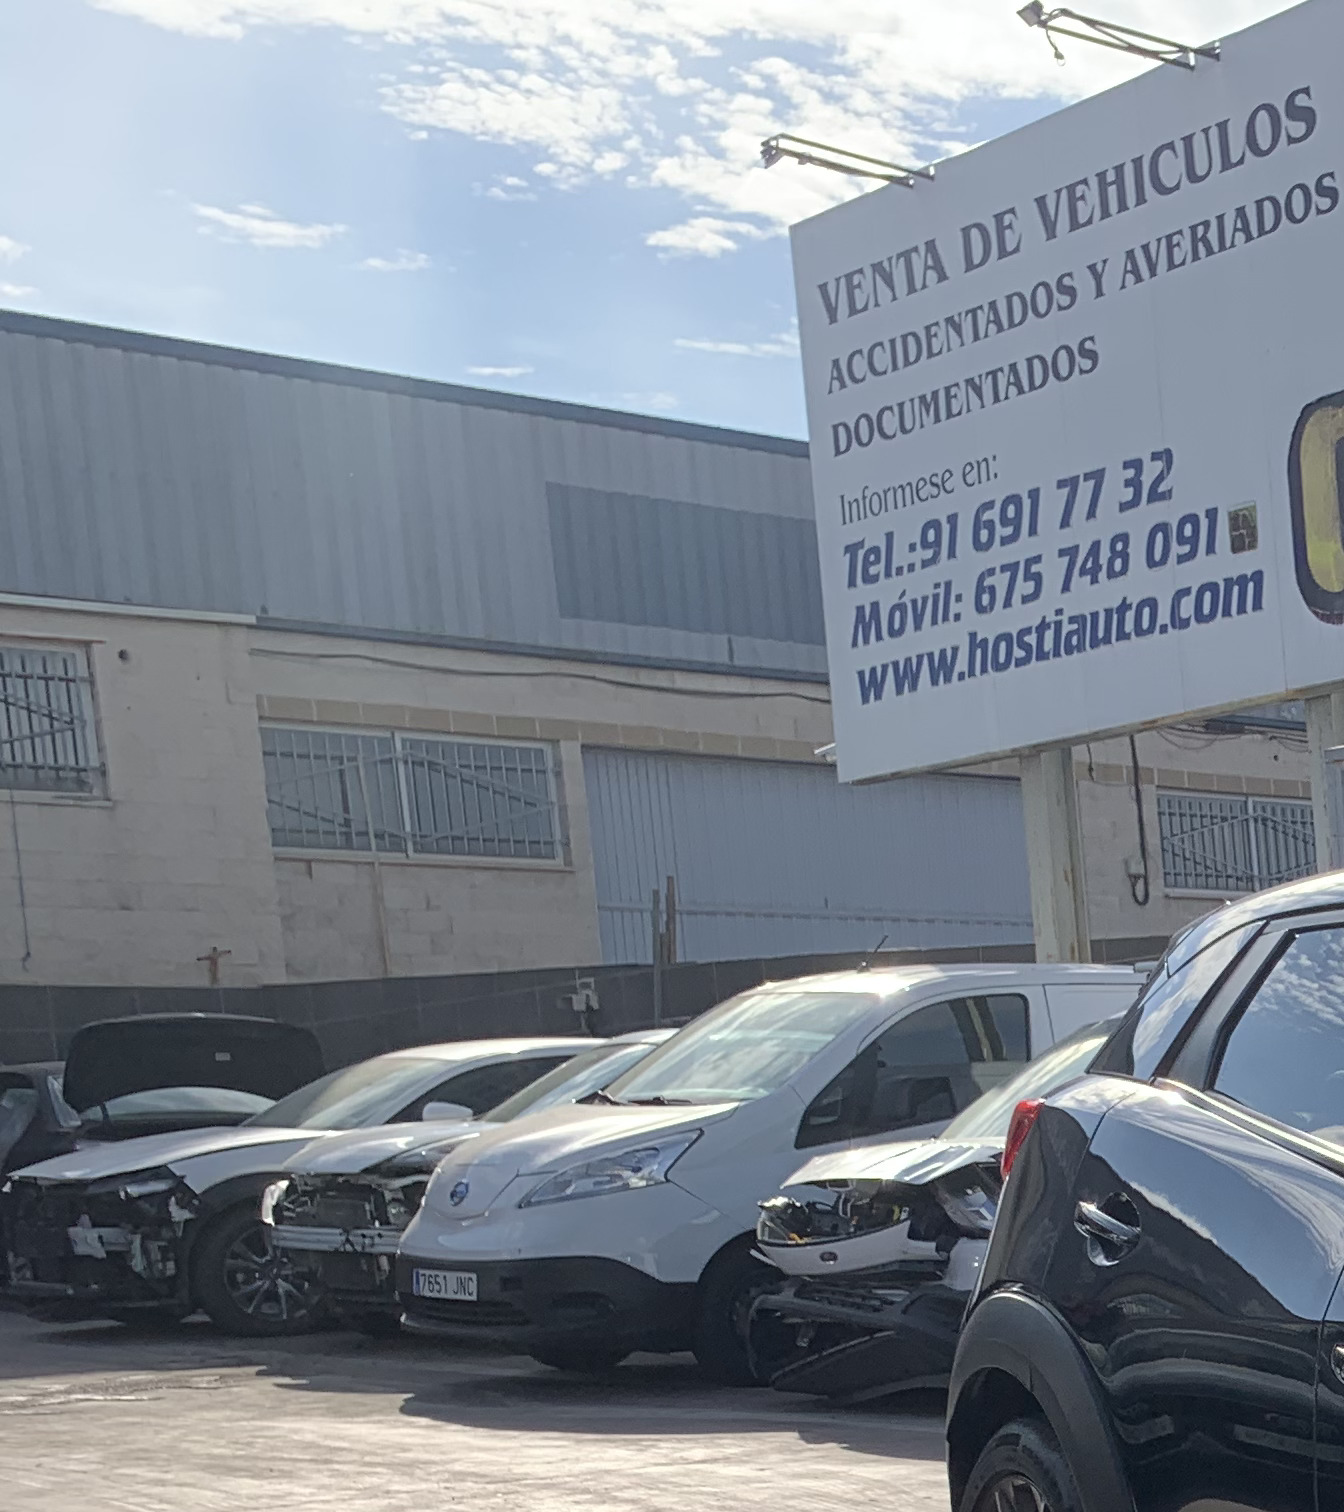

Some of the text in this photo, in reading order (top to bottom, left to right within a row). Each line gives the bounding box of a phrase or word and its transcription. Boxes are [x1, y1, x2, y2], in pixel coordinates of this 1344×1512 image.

[816, 85, 1318, 326] VENTA DE VEHICULOS
[827, 171, 1340, 396] ACCIDENTADOS Y AVERIADOS
[830, 335, 1101, 458] DOCUMENTADOS
[839, 453, 999, 526] Informese en:
[971, 487, 1041, 554] 691
[1056, 467, 1106, 530] 77
[1118, 447, 1175, 513] 32
[850, 506, 1219, 650] Móvil: 675 748 091
[856, 568, 1265, 706] www.hostiauto.com
[421, 1273, 474, 1297] 7651 JNC
